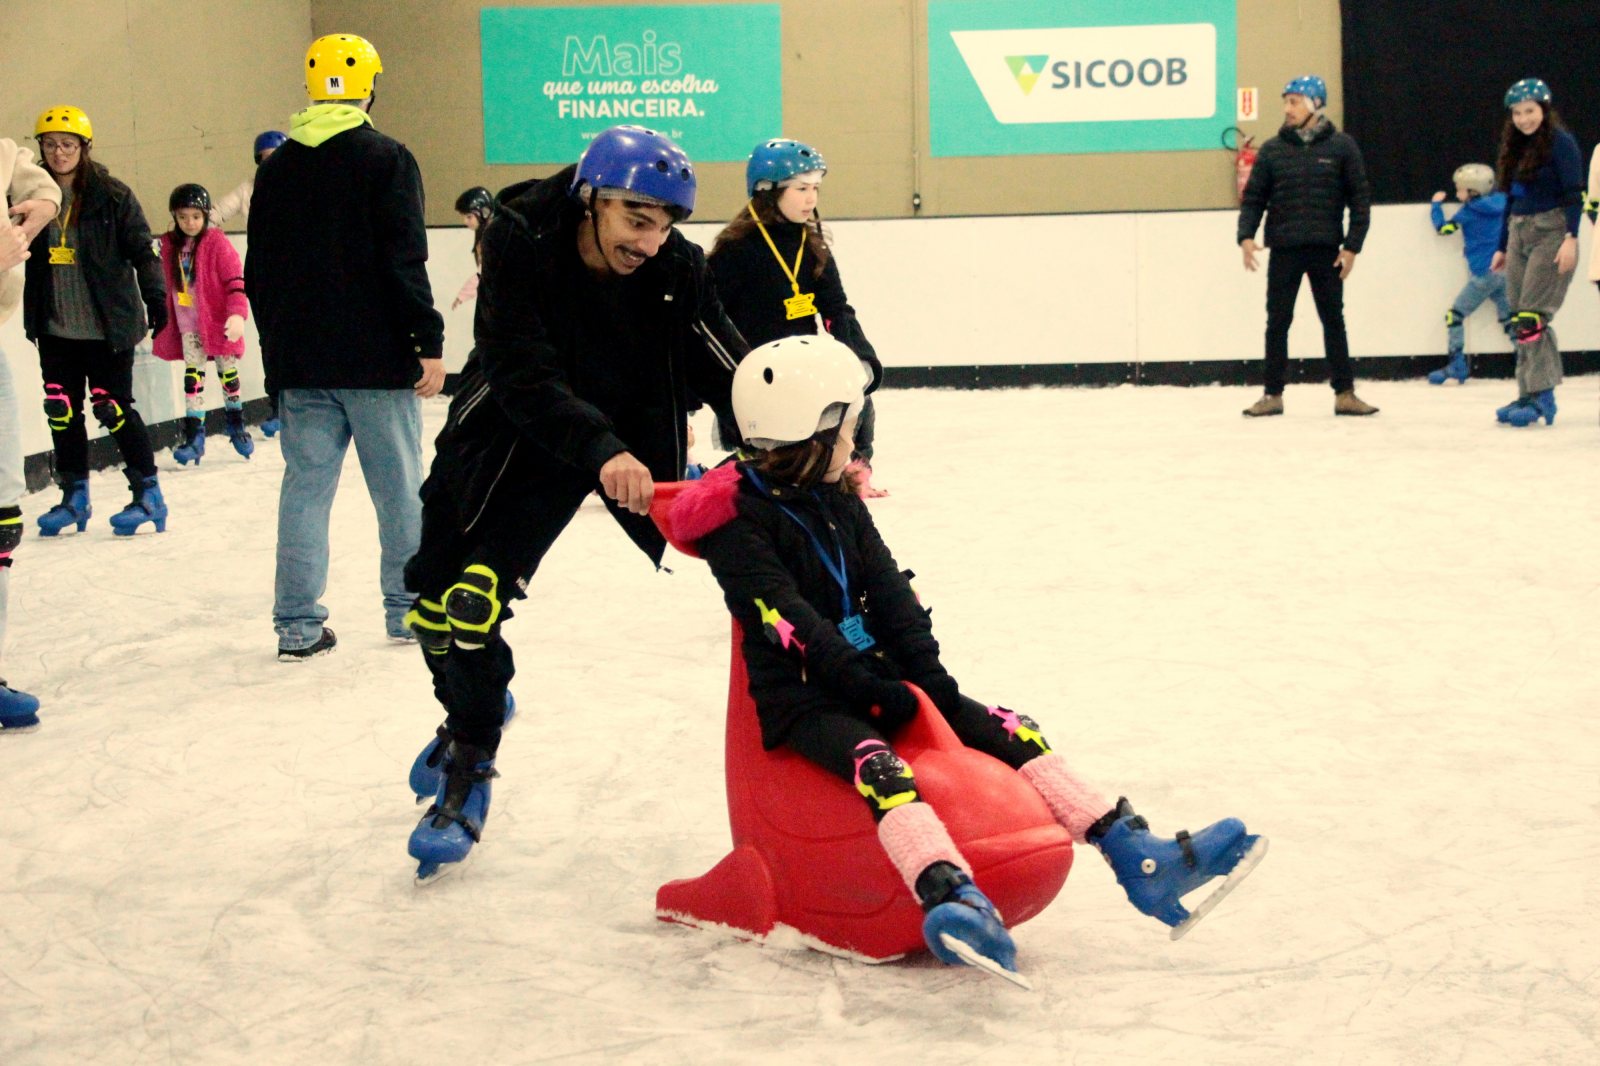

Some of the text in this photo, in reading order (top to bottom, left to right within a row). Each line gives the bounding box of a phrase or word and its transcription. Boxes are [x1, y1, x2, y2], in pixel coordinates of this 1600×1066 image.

[562, 30, 682, 76] Mais
[330, 78, 339, 87] M
[1051, 58, 1187, 89] SICOOB
[543, 74, 718, 100] que uma escolha
[559, 99, 705, 118] FINANCEIRA.
